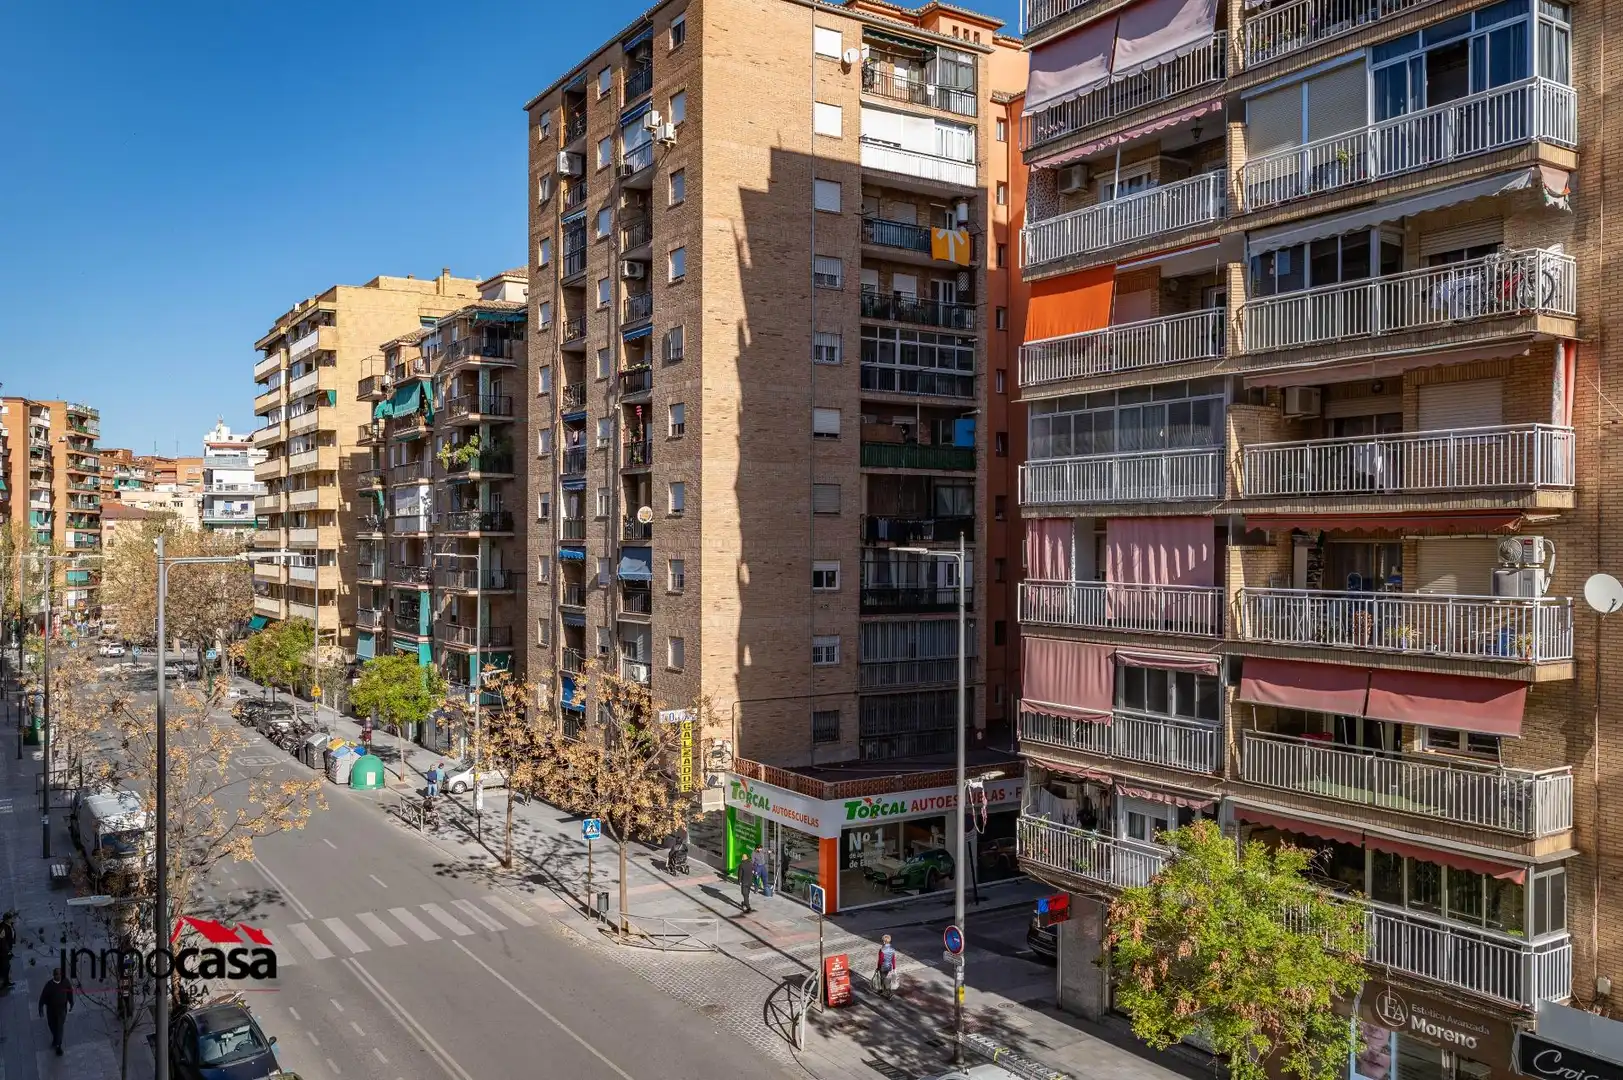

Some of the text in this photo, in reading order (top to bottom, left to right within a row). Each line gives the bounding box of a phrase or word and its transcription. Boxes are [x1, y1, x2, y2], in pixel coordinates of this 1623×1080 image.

[682, 721, 691, 791] CALZADOS
[910, 788, 1006, 812] AUTOESUELAS
[771, 804, 820, 828] AUTOESCUELAS
[875, 827, 885, 849] 1
[1411, 1014, 1478, 1050] Moreno
[1447, 1015, 1490, 1036] Avanzada
